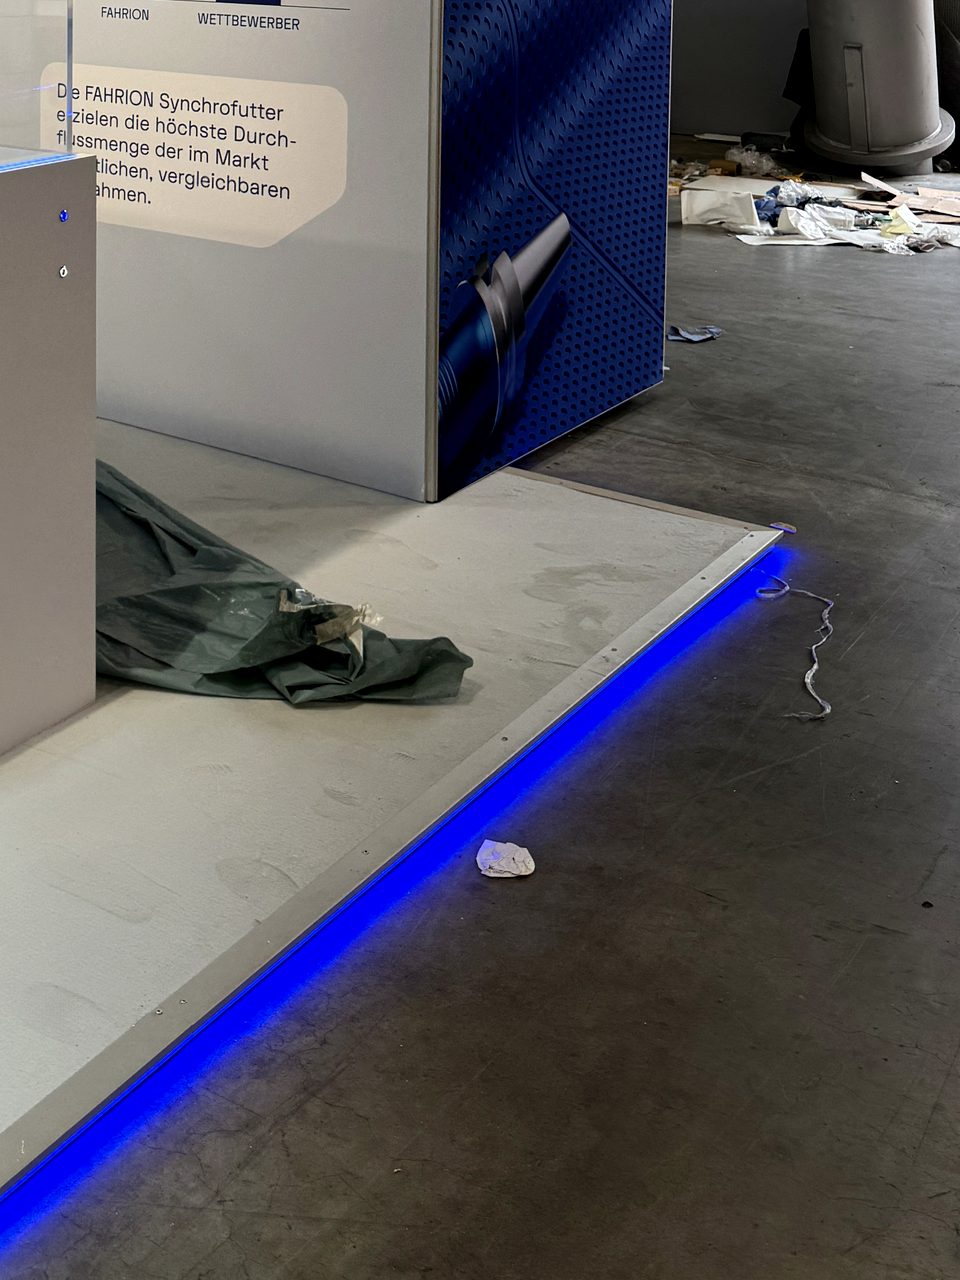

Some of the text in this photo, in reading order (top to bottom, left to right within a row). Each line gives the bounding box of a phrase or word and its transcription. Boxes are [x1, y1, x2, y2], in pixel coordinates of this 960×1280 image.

[101, 6, 150, 20] FAHRION
[197, 12, 300, 31] WETTBEWERBER
[57, 83, 284, 121] De FAHRION Synchrofutter
[57, 108, 296, 148] ezielen die höchste Durch-
[155, 142, 183, 159] der
[189, 145, 209, 163] im
[215, 148, 269, 171] Markt
[158, 170, 290, 200] vergleichbaren
